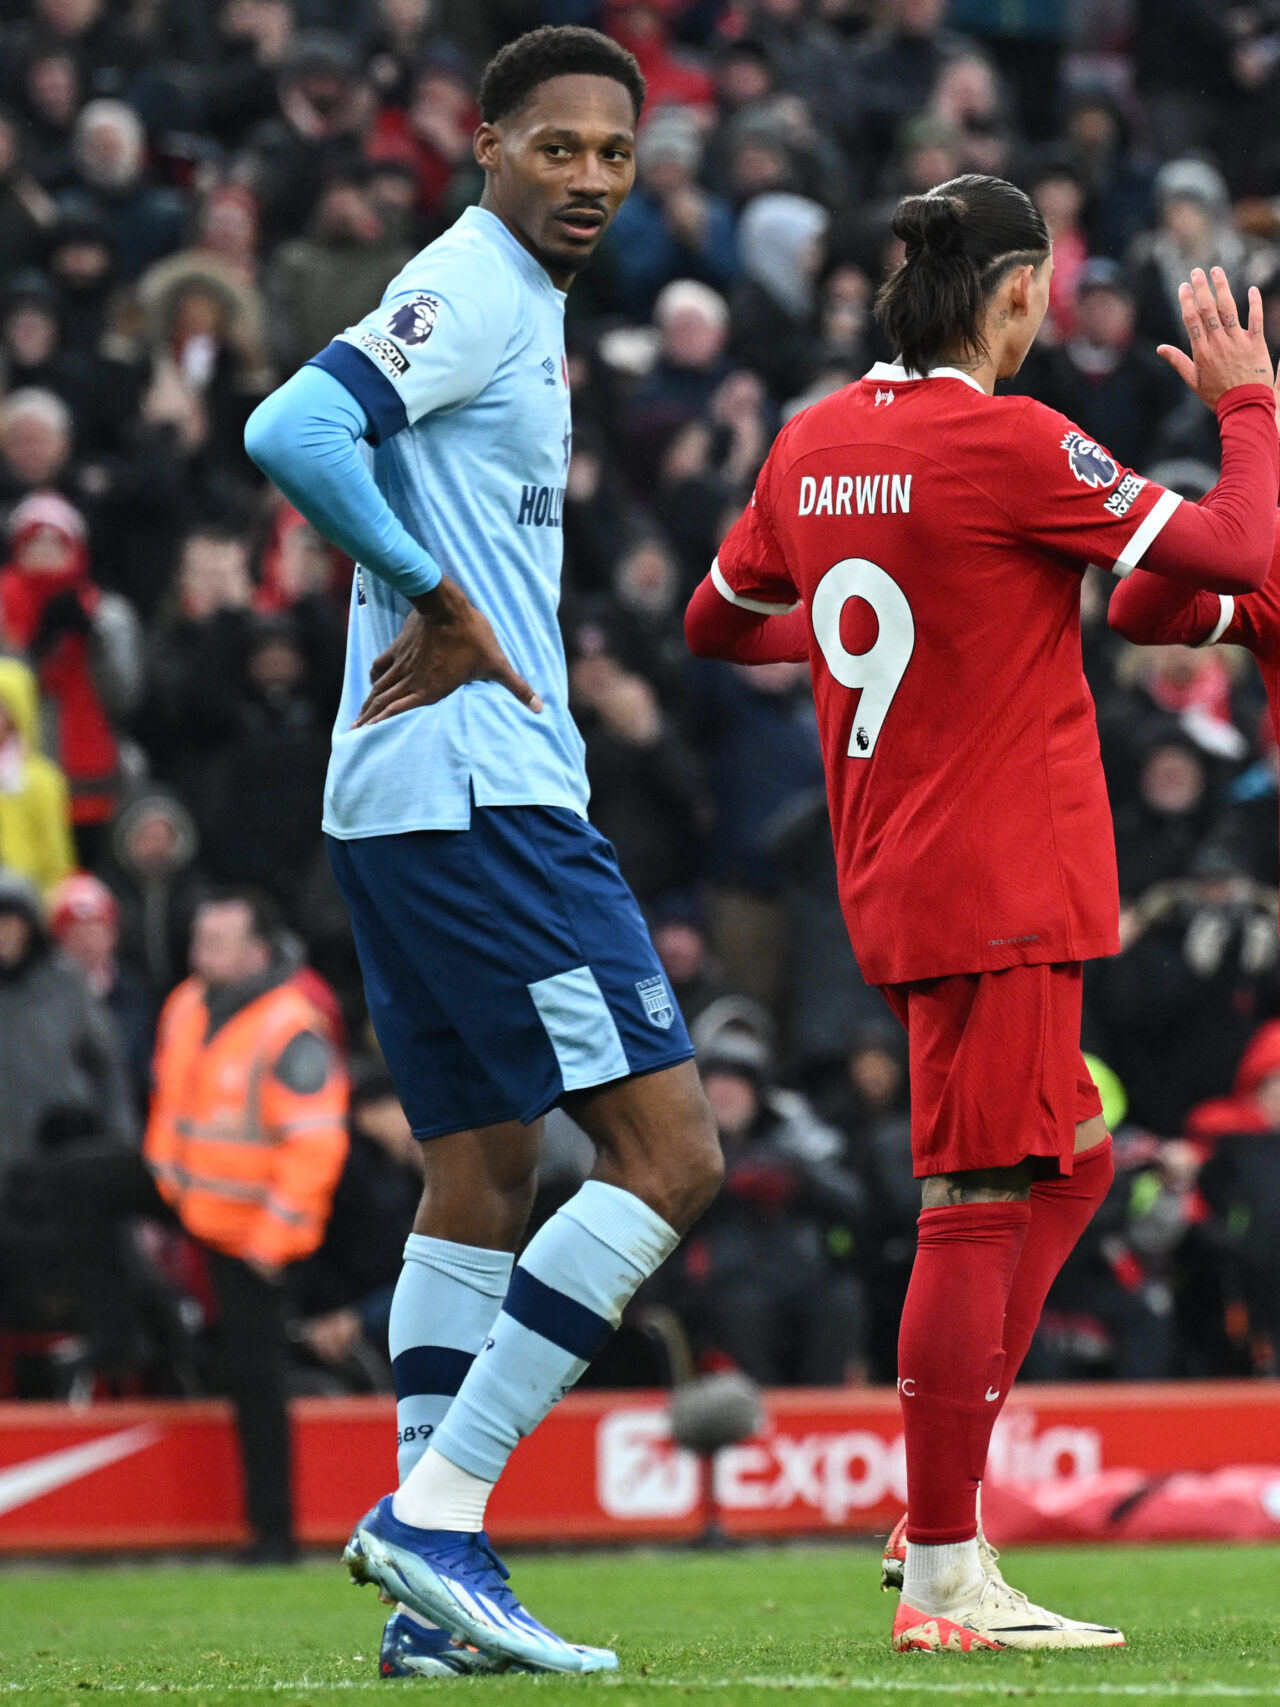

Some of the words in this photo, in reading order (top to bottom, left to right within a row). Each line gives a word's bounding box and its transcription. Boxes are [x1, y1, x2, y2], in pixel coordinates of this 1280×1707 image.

[798, 474, 913, 516] DARWIN
[1103, 493, 1122, 513] No
[811, 557, 916, 759] 9
